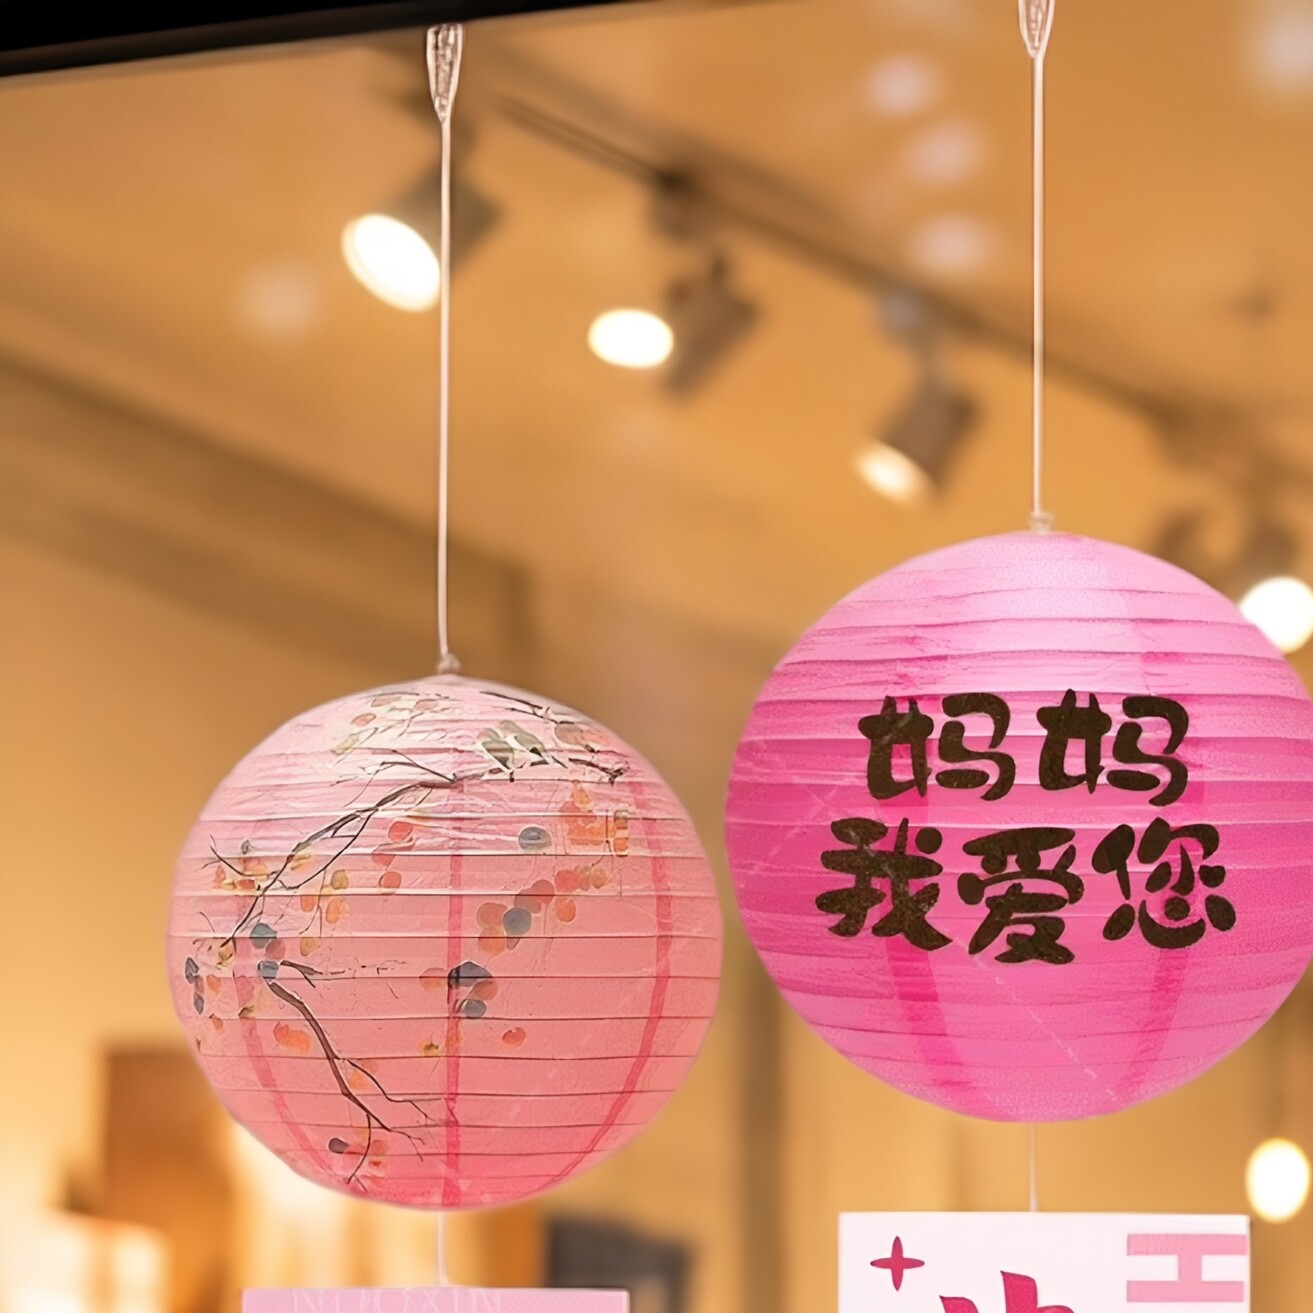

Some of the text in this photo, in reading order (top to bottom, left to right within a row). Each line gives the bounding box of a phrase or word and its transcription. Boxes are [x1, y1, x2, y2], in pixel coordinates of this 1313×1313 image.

[857, 688, 1190, 807] 妈妈
[814, 817, 1237, 965] 我爱您
